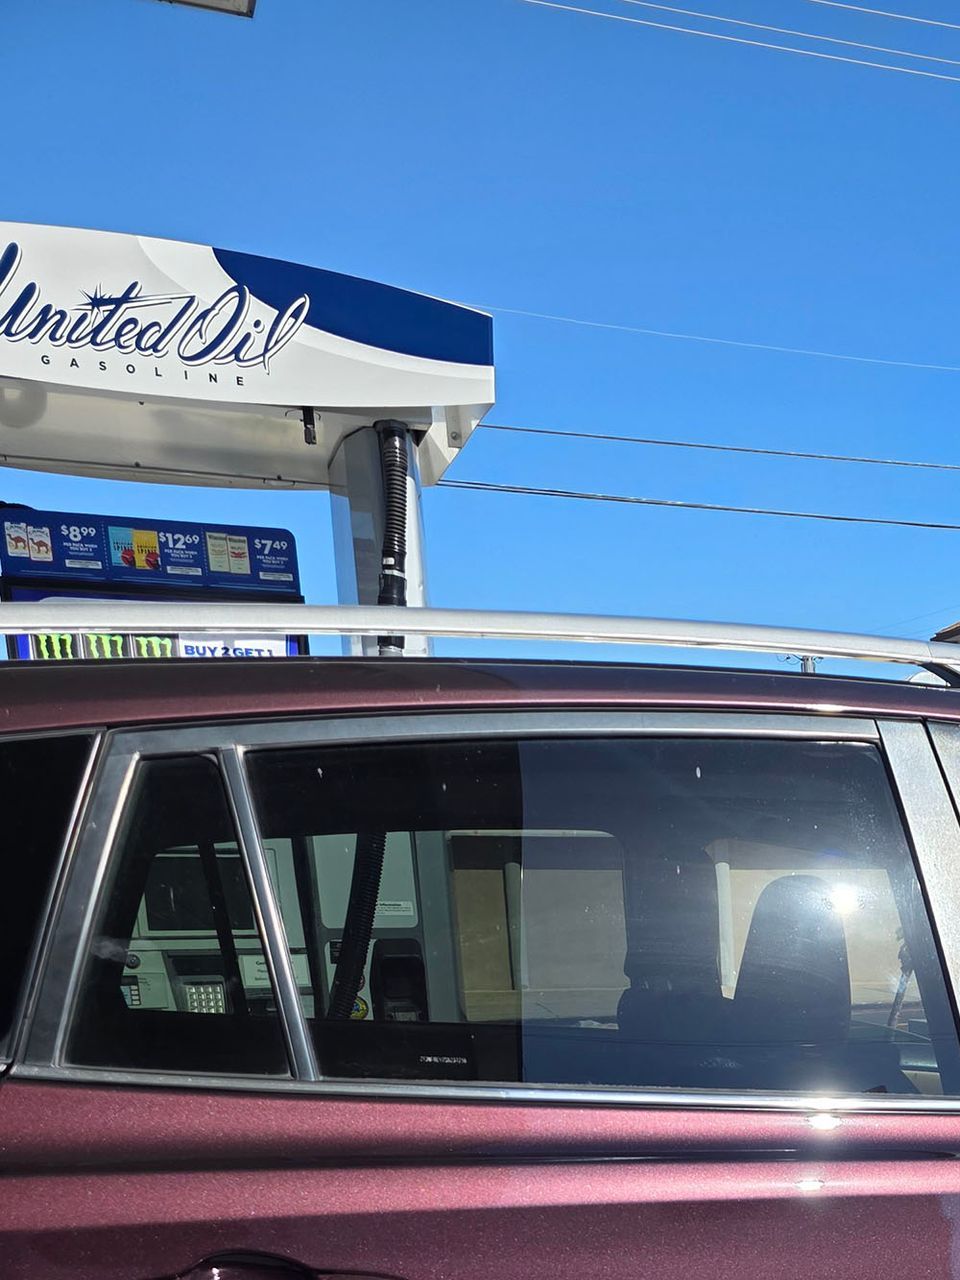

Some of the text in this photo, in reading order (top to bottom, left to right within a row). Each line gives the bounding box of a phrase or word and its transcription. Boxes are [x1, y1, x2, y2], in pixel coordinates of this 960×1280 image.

[0, 241, 310, 375] United Oil
[40, 354, 245, 386] GASOLINE
[184, 644, 218, 657] BUY
[221, 646, 231, 657] 2
[232, 647, 265, 657] GET
